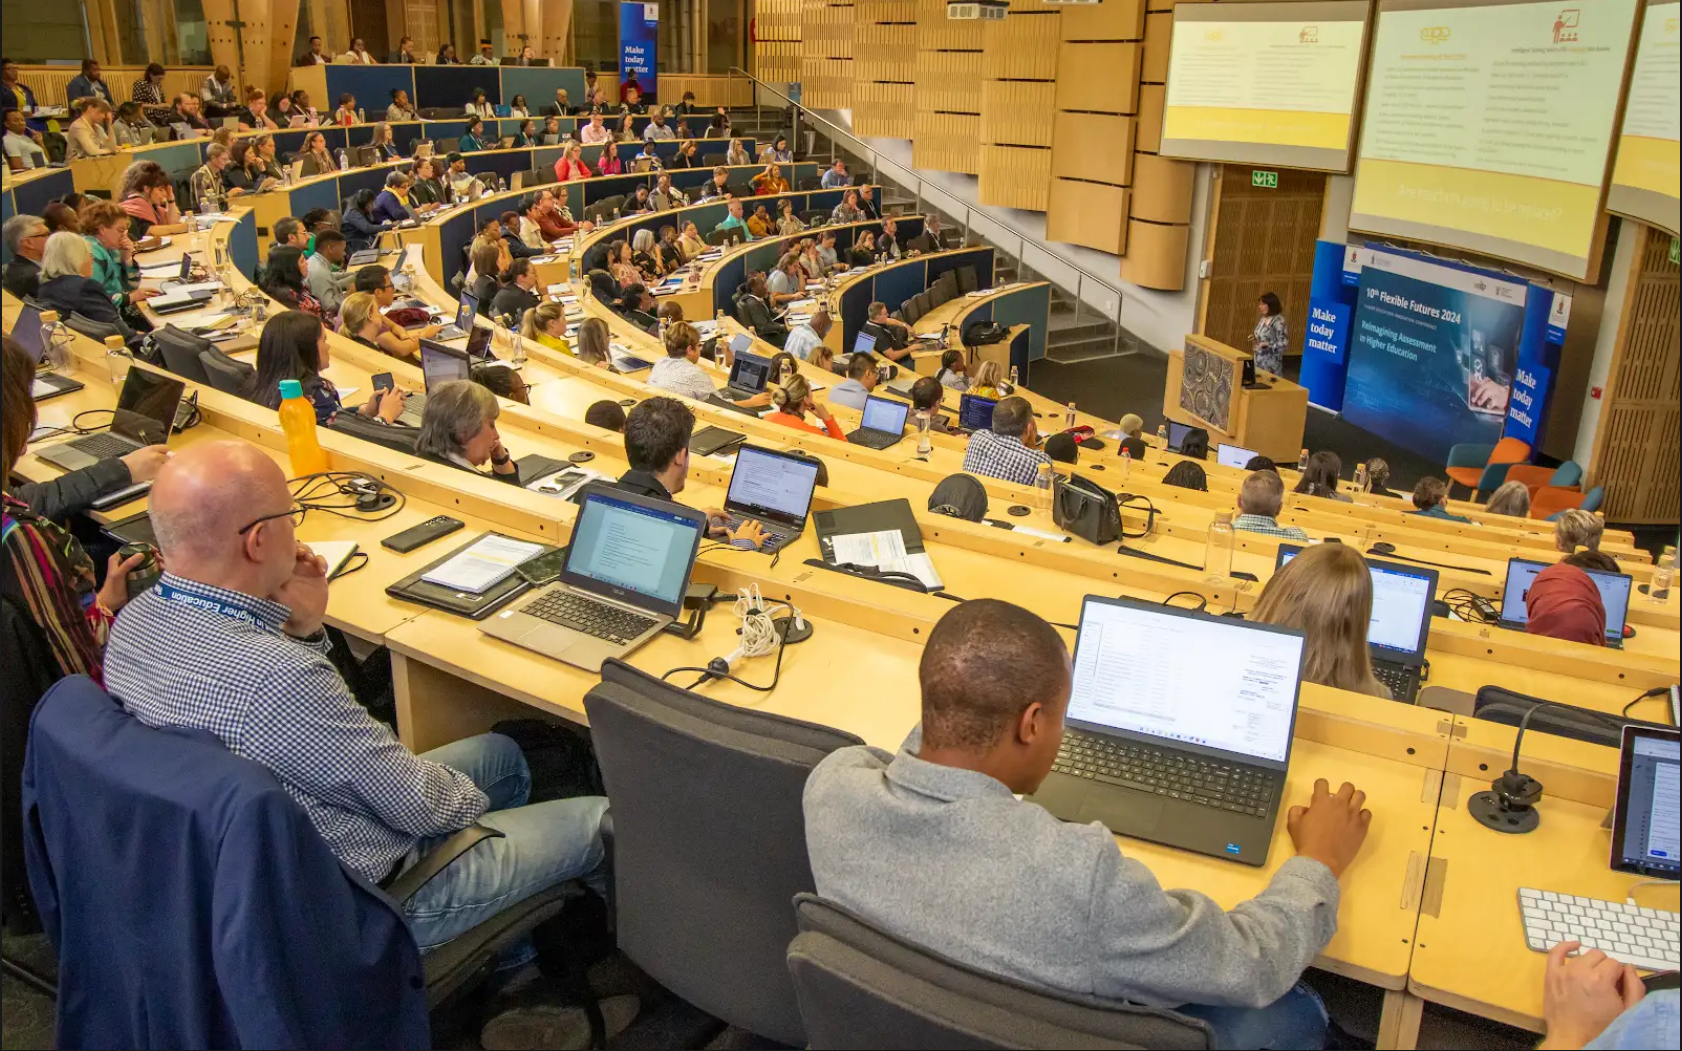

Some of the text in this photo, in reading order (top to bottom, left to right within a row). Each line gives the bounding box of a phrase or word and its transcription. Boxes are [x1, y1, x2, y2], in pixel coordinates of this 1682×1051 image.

[625, 46, 644, 54] Make
[625, 55, 644, 65] today
[1312, 307, 1337, 323] Make
[1366, 287, 1461, 324] 10th Flexible Futures 2024
[1310, 322, 1335, 340] today
[1361, 320, 1437, 353] Reimagining Assessment
[1308, 338, 1338, 354] matter
[1359, 333, 1418, 361] in Higher Education
[1516, 368, 1537, 390] Make
[1513, 387, 1533, 410] today
[1510, 406, 1533, 429] matter
[171, 591, 221, 613] Education
[221, 606, 256, 627] Higher
